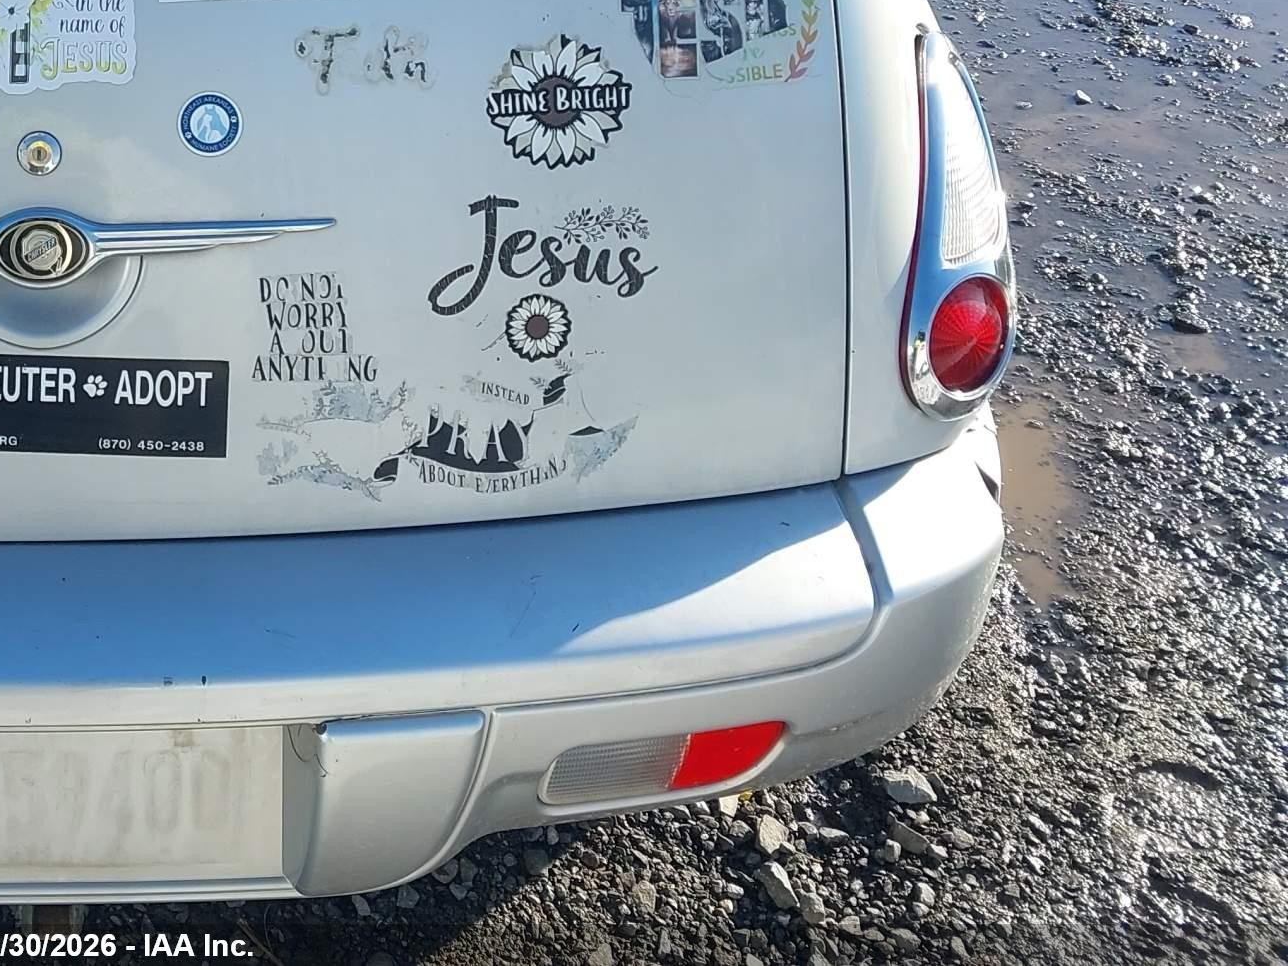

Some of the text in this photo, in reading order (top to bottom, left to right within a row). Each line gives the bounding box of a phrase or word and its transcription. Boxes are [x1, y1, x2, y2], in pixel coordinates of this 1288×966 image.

[59, 15, 126, 38] name of
[40, 37, 129, 81] JESUS
[487, 86, 631, 116] SHINE BRIGHT
[428, 195, 658, 316] Jesus
[270, 329, 347, 355] AOUT
[114, 370, 214, 407] ADOPT
[481, 381, 530, 405] INSTEAD
[98, 437, 131, 451] (870)
[137, 439, 205, 452] 450-2438
[418, 460, 466, 487] ABOUT
